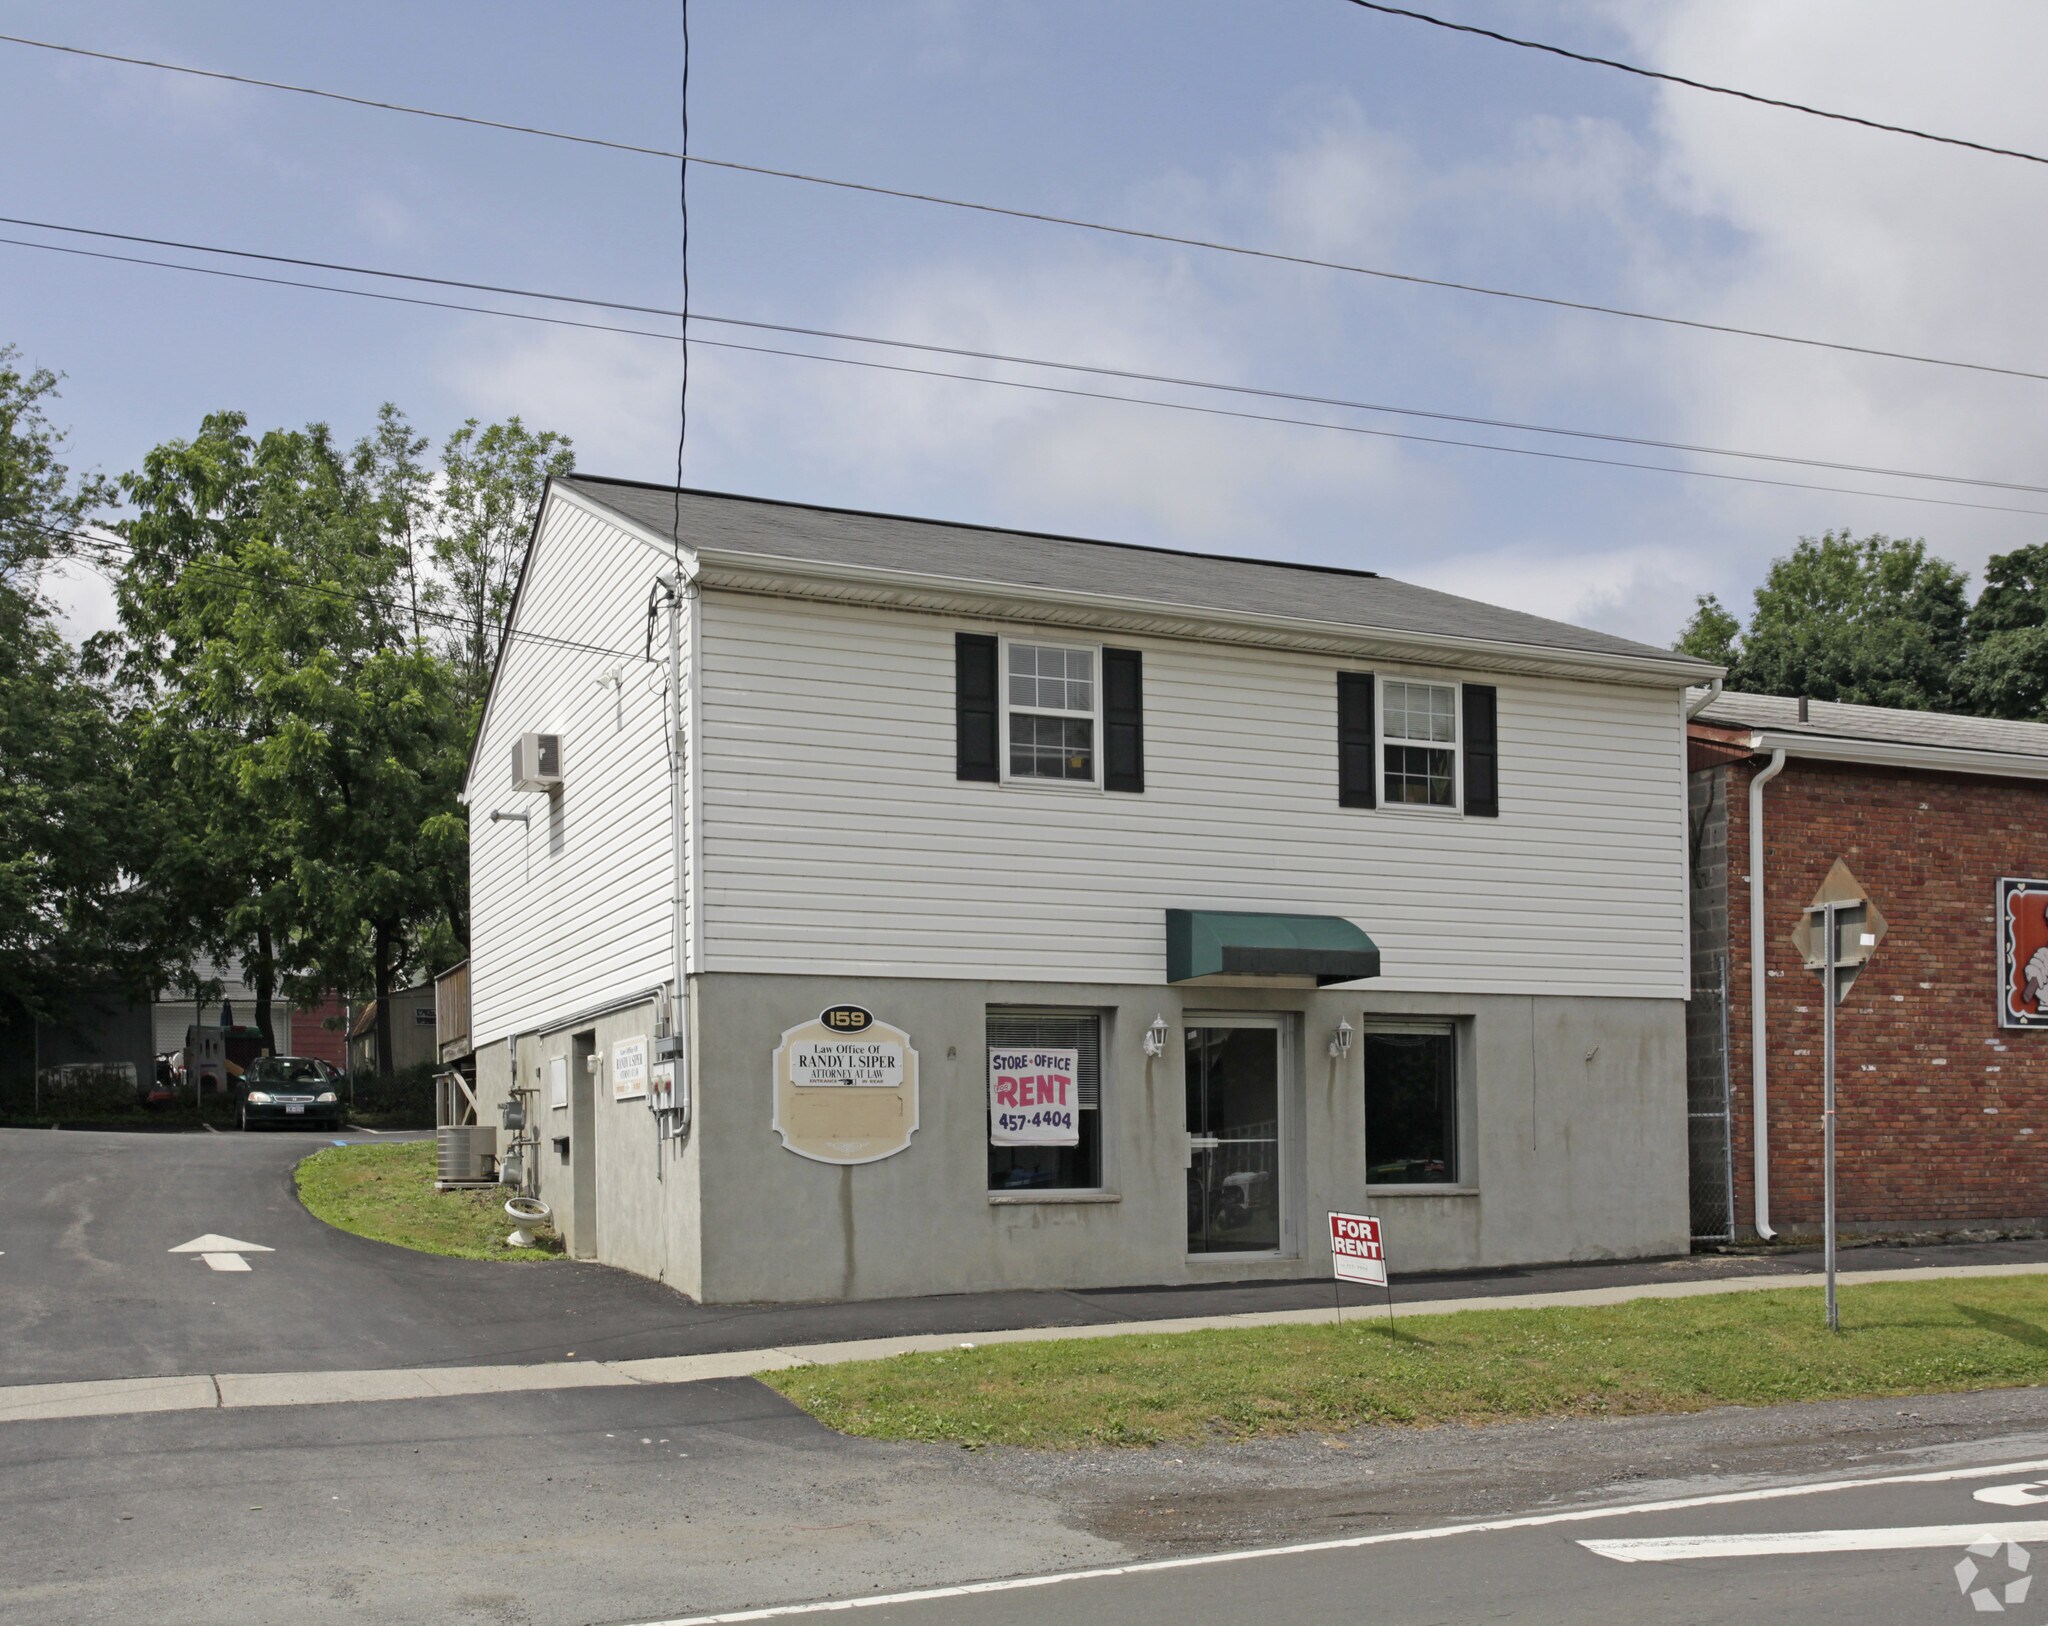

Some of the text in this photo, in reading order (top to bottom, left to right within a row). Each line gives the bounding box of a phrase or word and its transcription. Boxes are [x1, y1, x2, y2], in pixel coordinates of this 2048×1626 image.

[830, 1011, 865, 1026] 159
[814, 1044, 881, 1054] Law Office Of
[799, 1055, 847, 1068] RANDY
[858, 1055, 896, 1068] SIPER
[993, 1054, 1071, 1071] STORE OFFICE
[810, 1069, 884, 1078] ATTORNEY AT LAW
[997, 1074, 1071, 1109] RENT
[1337, 1220, 1372, 1240] FOR
[1334, 1236, 1379, 1258] RENT
